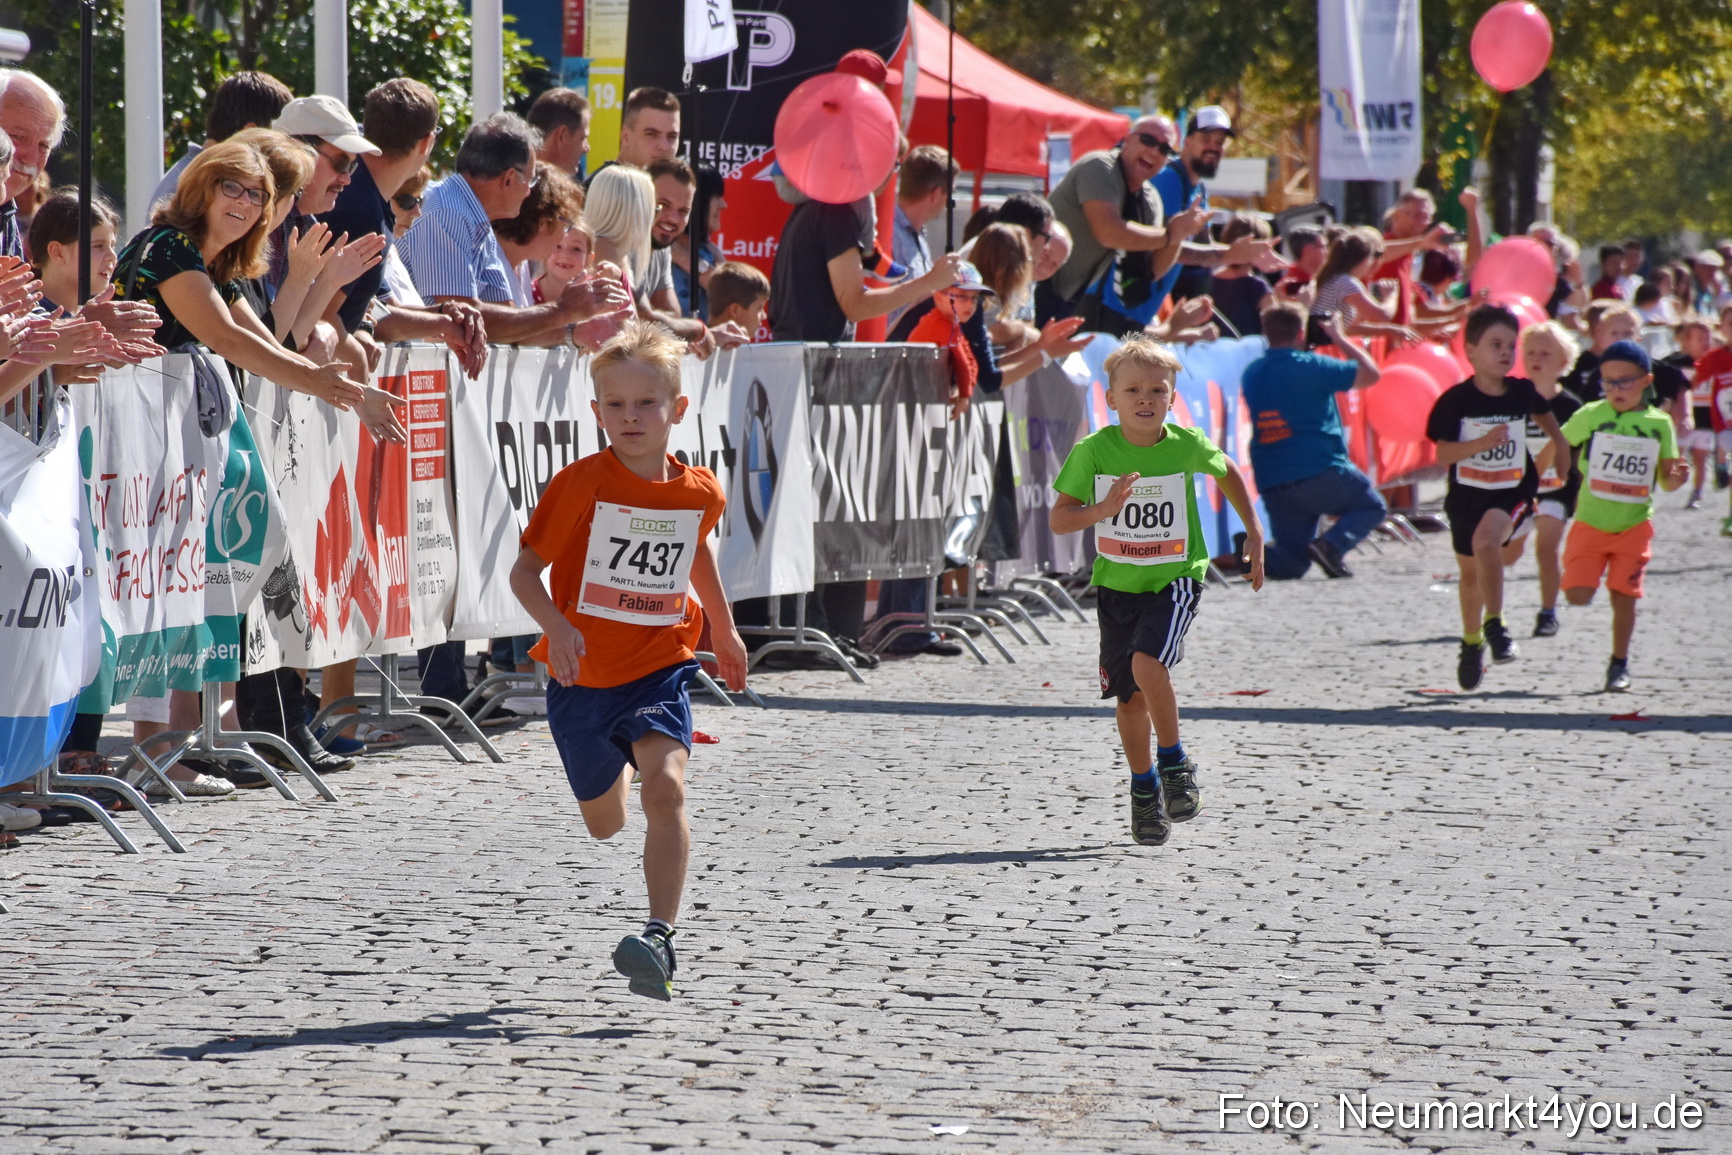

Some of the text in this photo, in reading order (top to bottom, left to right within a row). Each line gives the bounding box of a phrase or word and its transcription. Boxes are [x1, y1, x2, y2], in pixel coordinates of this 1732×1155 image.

[719, 143, 768, 163] NEXT
[1470, 440, 1516, 461] 580
[1601, 452, 1649, 476] 7465
[1131, 485, 1162, 496] OCK
[630, 518, 676, 532] BOCK
[1114, 530, 1162, 539] PARTL Neumarkt
[608, 536, 685, 577] 7437
[1120, 543, 1161, 556] Vincent
[590, 559, 600, 567] B2
[610, 576, 668, 589] PARTL Neumarkt
[618, 593, 664, 612] Fabian
